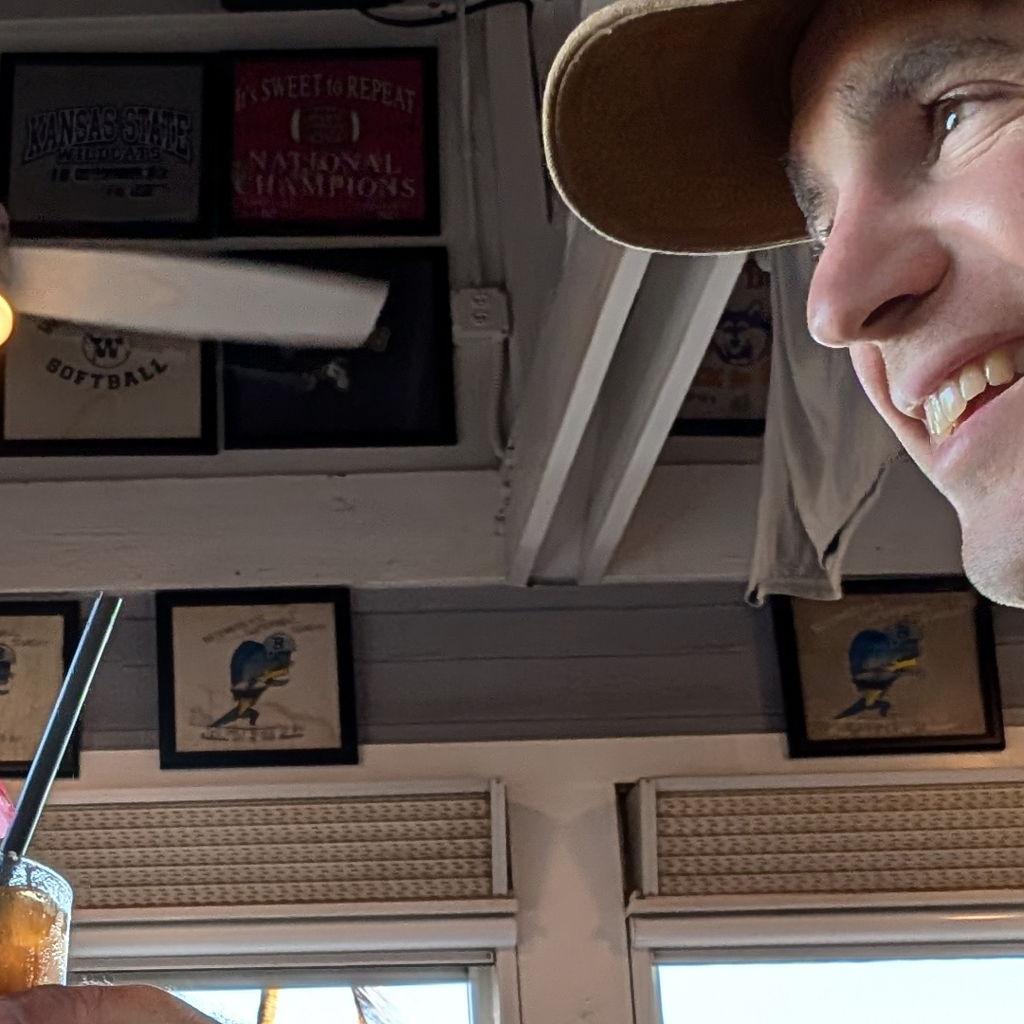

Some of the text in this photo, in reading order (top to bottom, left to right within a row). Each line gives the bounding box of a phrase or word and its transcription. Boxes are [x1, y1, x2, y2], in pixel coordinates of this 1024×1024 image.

[261, 73, 323, 102] SWEET
[327, 77, 344, 97] to
[347, 75, 416, 114] REPEAT
[23, 105, 192, 165] KANSAS STATE
[249, 149, 403, 175] NATIONAL
[233, 170, 417, 199] CHAMPIONS
[45, 357, 169, 390] SOFTBALL
